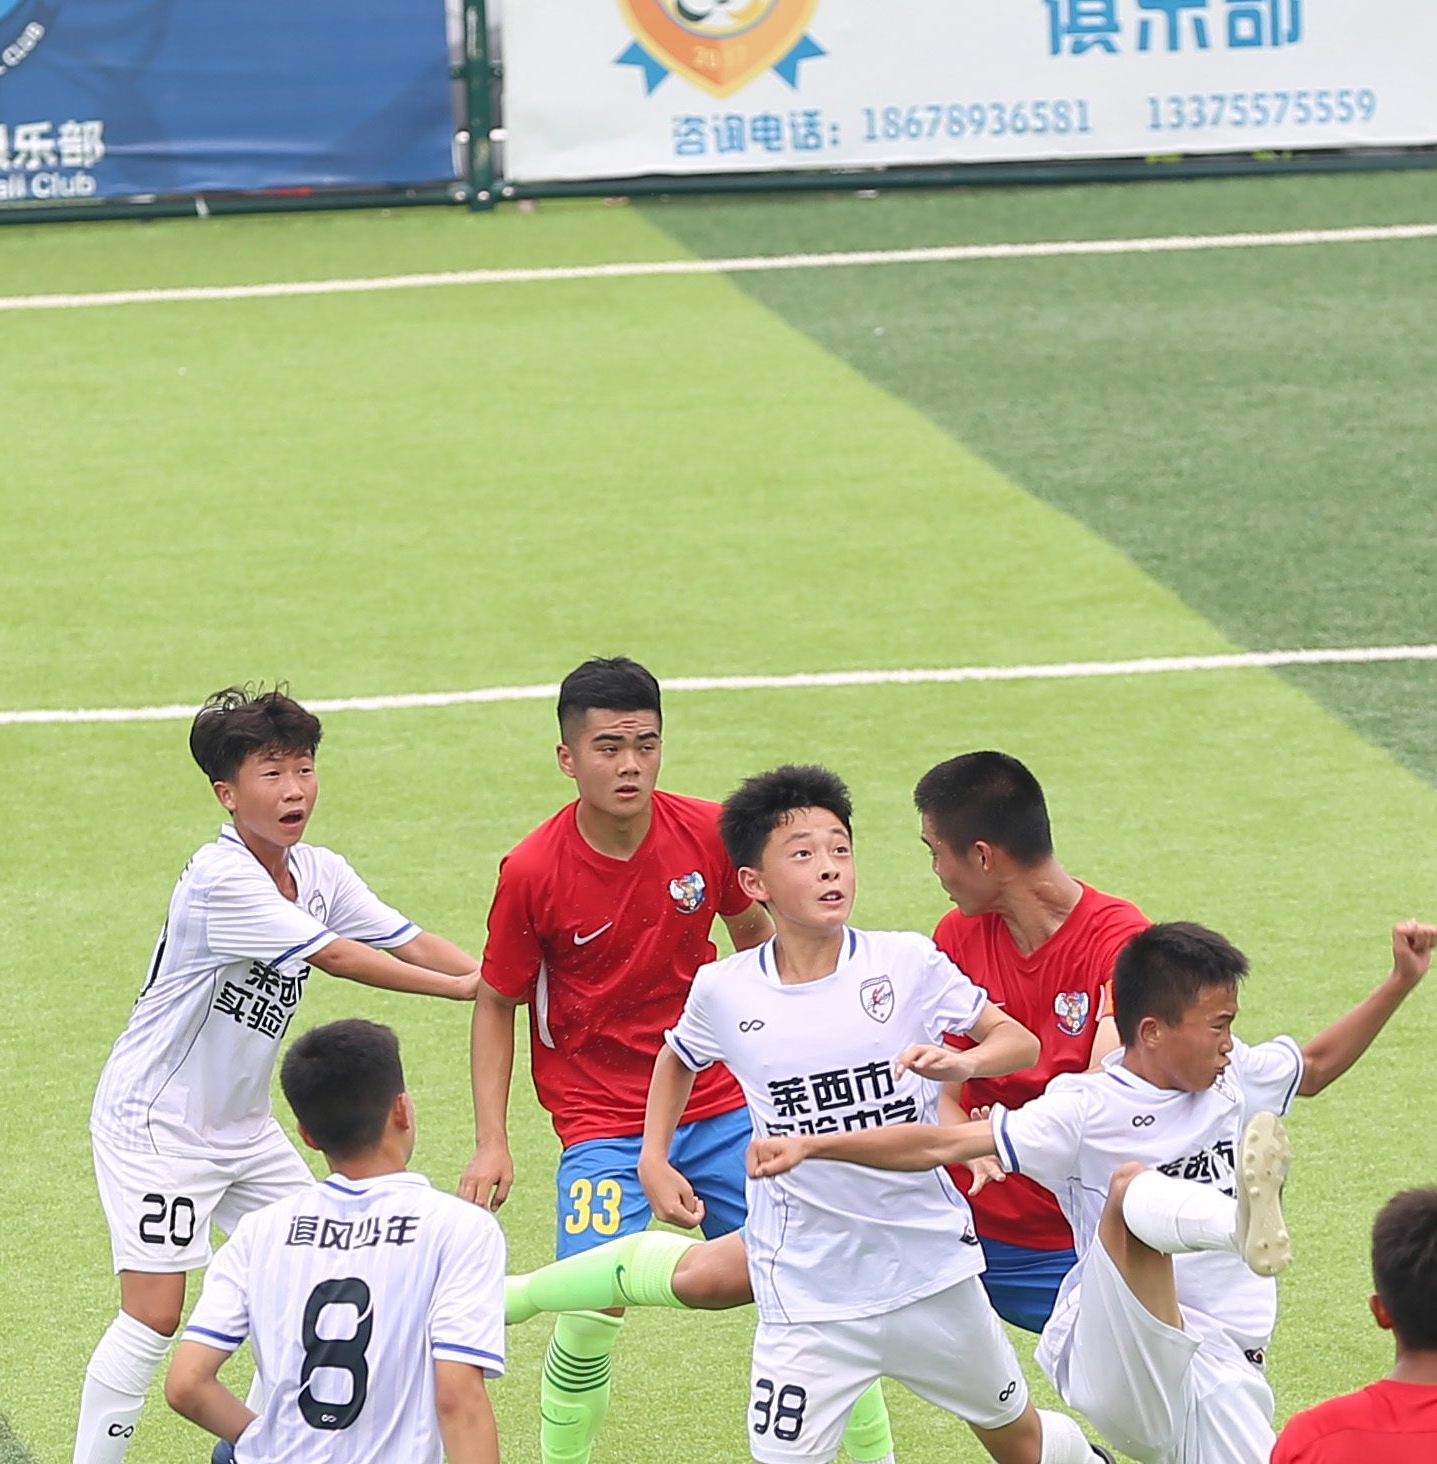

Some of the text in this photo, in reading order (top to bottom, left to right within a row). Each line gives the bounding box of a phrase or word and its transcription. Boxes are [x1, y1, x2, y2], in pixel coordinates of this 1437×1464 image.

[1044, 0, 1300, 55] 俱乐部
[862, 99, 1091, 142] 18678936581
[1147, 89, 1377, 131] 13375575559
[31, 171, 96, 199] Club
[767, 1060, 895, 1117] 莱西市
[139, 1193, 196, 1247] 20
[285, 1215, 420, 1250] 追风少年
[564, 1178, 622, 1235] 33
[298, 1277, 373, 1430] 8
[754, 1378, 807, 1441] 38
